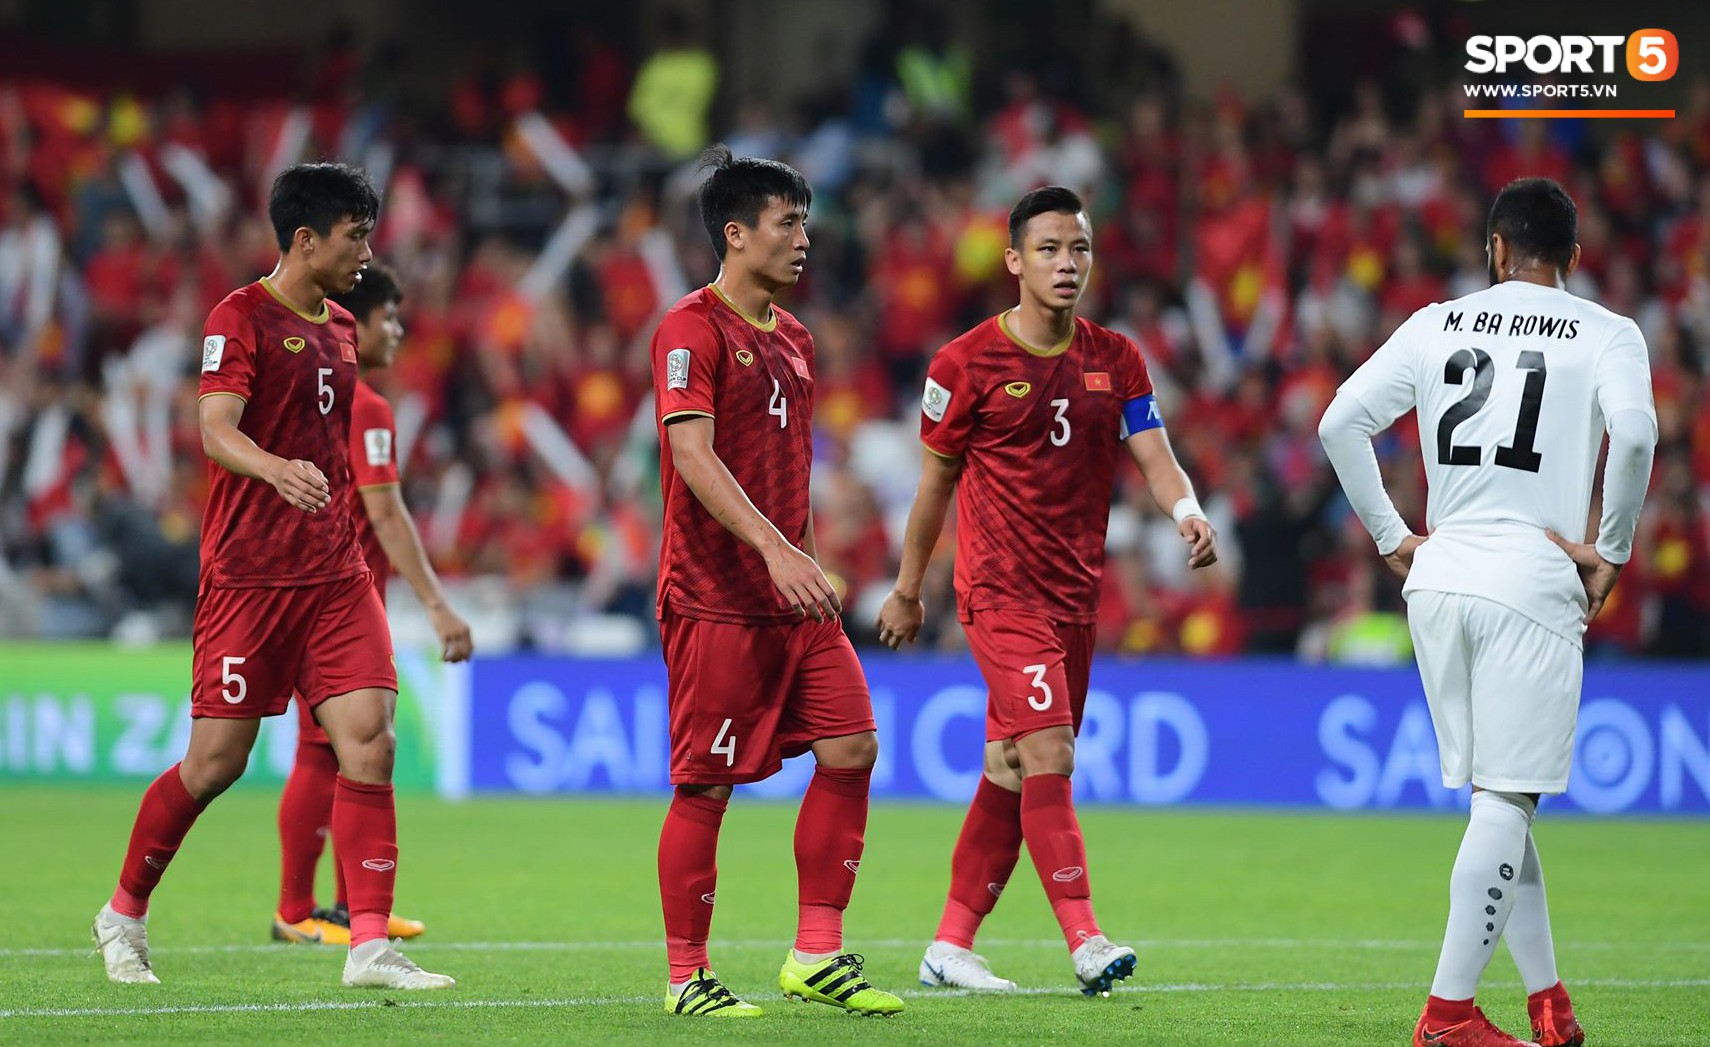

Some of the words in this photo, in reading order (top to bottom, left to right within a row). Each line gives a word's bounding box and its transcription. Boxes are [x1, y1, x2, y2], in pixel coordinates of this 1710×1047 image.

[1443, 311, 1464, 332] M.
[1472, 311, 1503, 335] BA
[1508, 314, 1580, 340] ROWIS
[317, 368, 335, 415] 5
[768, 379, 787, 429] 4
[1437, 347, 1547, 473] 21
[1050, 399, 1071, 447] 3
[221, 656, 247, 704] 5
[1022, 664, 1053, 711] 3
[0, 692, 94, 773] IN
[710, 718, 736, 767] 4
[912, 684, 1209, 804] CRD
